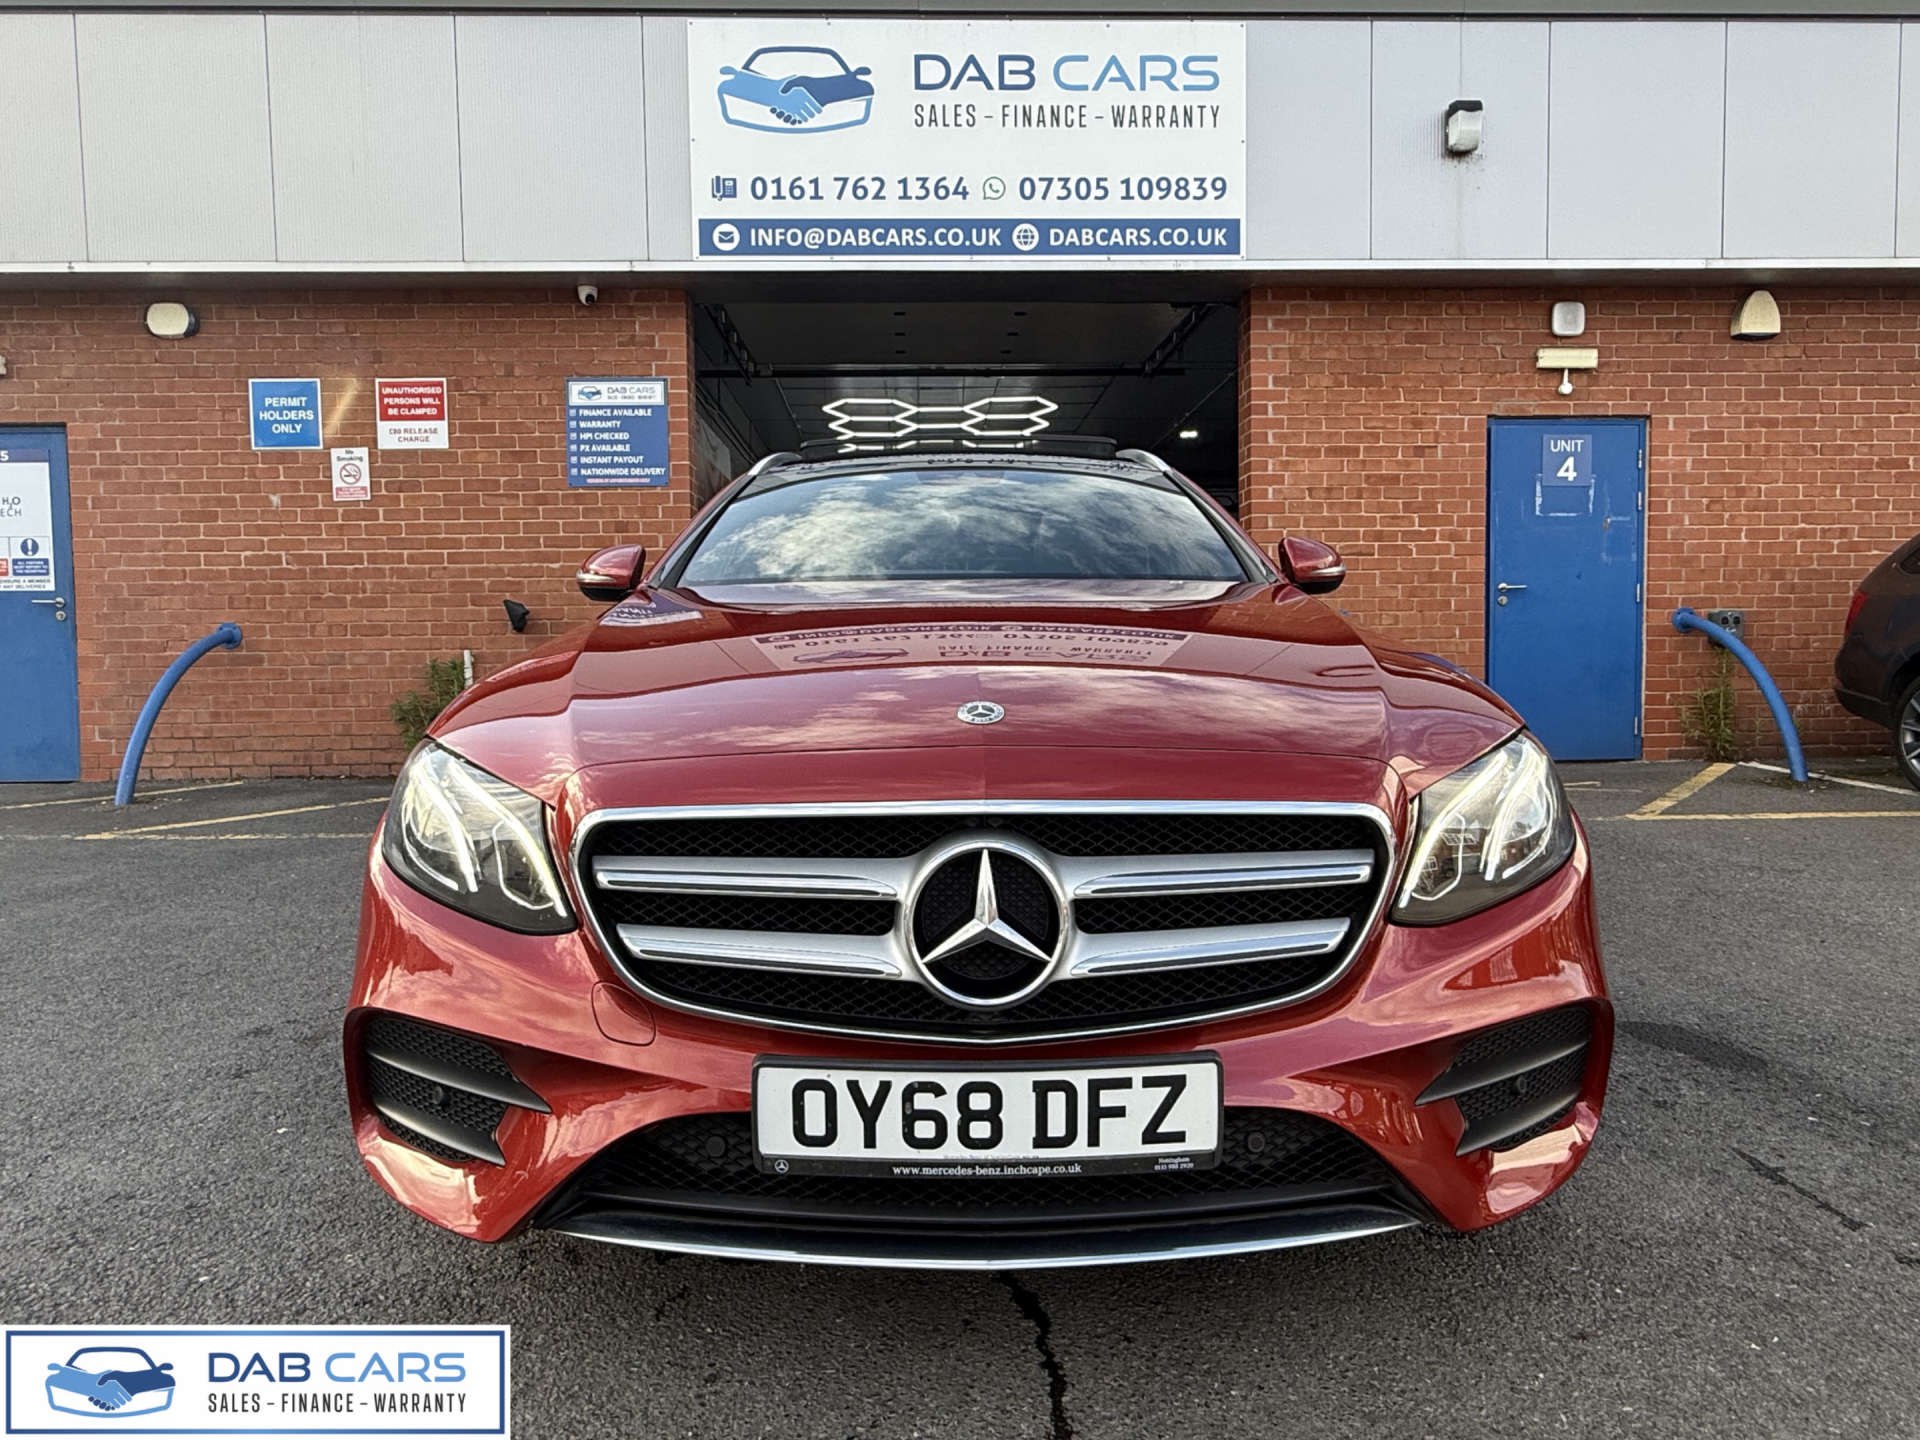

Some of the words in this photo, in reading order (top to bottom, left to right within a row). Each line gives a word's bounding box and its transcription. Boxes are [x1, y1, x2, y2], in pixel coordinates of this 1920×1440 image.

[914, 54, 1035, 90] DAB
[1053, 55, 1219, 91] CARS
[915, 104, 975, 127] SALES
[1002, 105, 1086, 127] FINANCE
[1112, 105, 1219, 128] WARRANTY
[751, 177, 824, 200] 0161
[834, 177, 886, 200] 762
[898, 177, 969, 200] 1364
[1020, 177, 1109, 200] 07305
[1121, 177, 1226, 200] 109839
[751, 228, 1001, 248] INFO@DABCARS.CO.UK
[1050, 228, 1226, 245] DABCARS.CO.UK
[381, 386, 443, 395] UNAUTHORISED
[264, 396, 308, 408] PERMIT
[383, 397, 421, 405] PERSONS
[421, 397, 441, 405] WILL
[259, 409, 315, 421] HOLDERS
[387, 407, 399, 416] BE
[399, 407, 438, 416] CLAMPED
[578, 408, 612, 417] FINANCE
[612, 408, 652, 417] AVAILABLE
[271, 423, 303, 434] ONLY
[578, 419, 622, 429] WARRANTY
[402, 427, 439, 435] RELEASE
[594, 431, 630, 441] CHECKED
[397, 435, 430, 443] CHARGE
[591, 443, 631, 452] AVAILABLE
[1550, 439, 1585, 453] UNIT
[579, 455, 611, 464] INSTANT
[613, 455, 644, 464] PAYOUT
[580, 467, 629, 476] NATIONWIDE
[630, 467, 667, 476] DELIVERY
[1556, 456, 1577, 482] 4
[792, 1078, 1004, 1150] OY68
[1032, 1074, 1187, 1149] DFZ
[892, 1162, 1083, 1177] www.mercedes-benz.inchcape.co.uk
